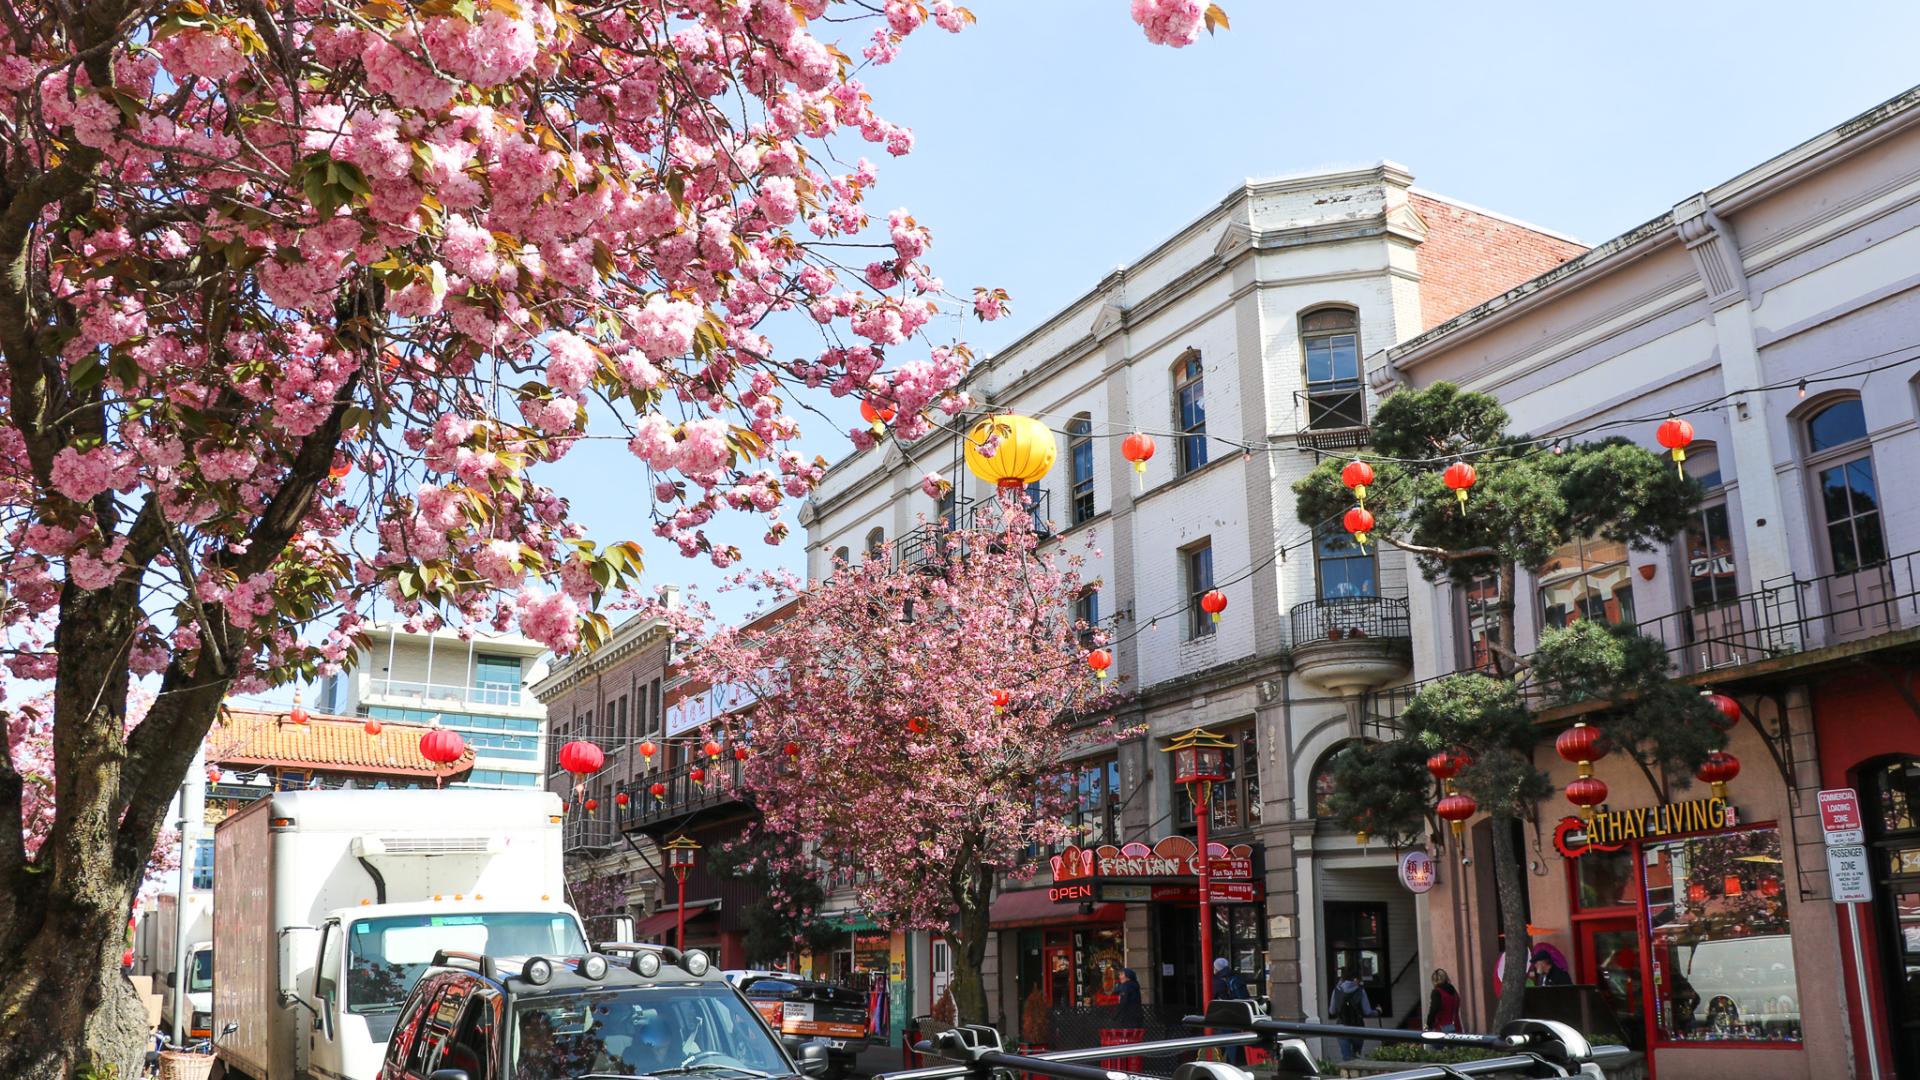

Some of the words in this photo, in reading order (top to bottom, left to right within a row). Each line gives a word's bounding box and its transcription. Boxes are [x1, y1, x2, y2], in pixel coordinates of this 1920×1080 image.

[1827, 803, 1851, 812] LOADING
[1653, 797, 1724, 836] LIVING
[1833, 814, 1849, 823] ZONE
[1830, 847, 1864, 858] PASSENGER
[1840, 861, 1856, 870] ZONE
[1049, 884, 1092, 902] OPEN
